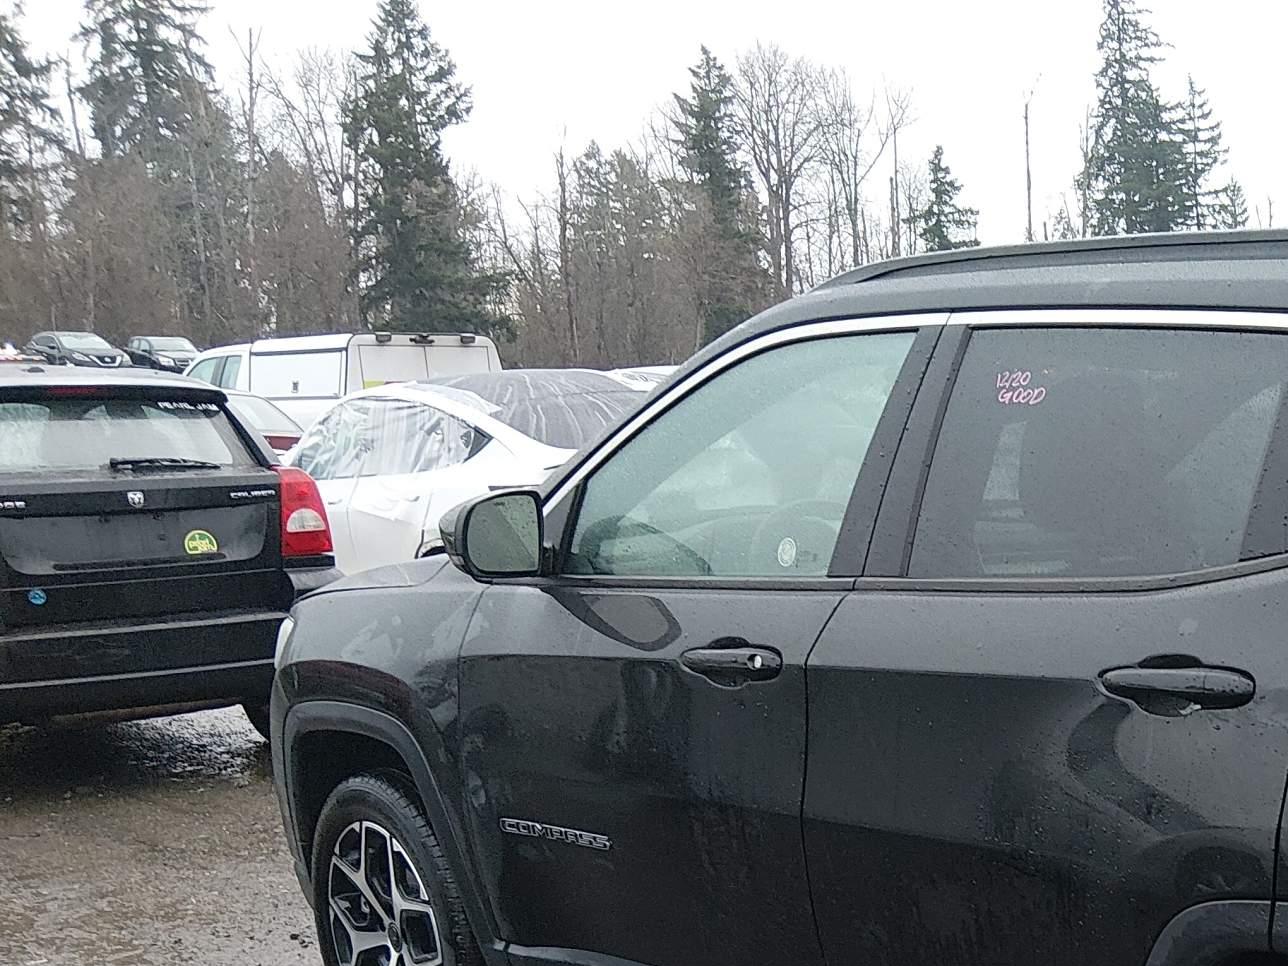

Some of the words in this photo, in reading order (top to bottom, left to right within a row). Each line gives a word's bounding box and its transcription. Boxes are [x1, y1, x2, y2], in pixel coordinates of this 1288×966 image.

[996, 370, 1032, 389] 12/20
[998, 387, 1046, 405] GOOD
[499, 817, 610, 851] COMPASS
